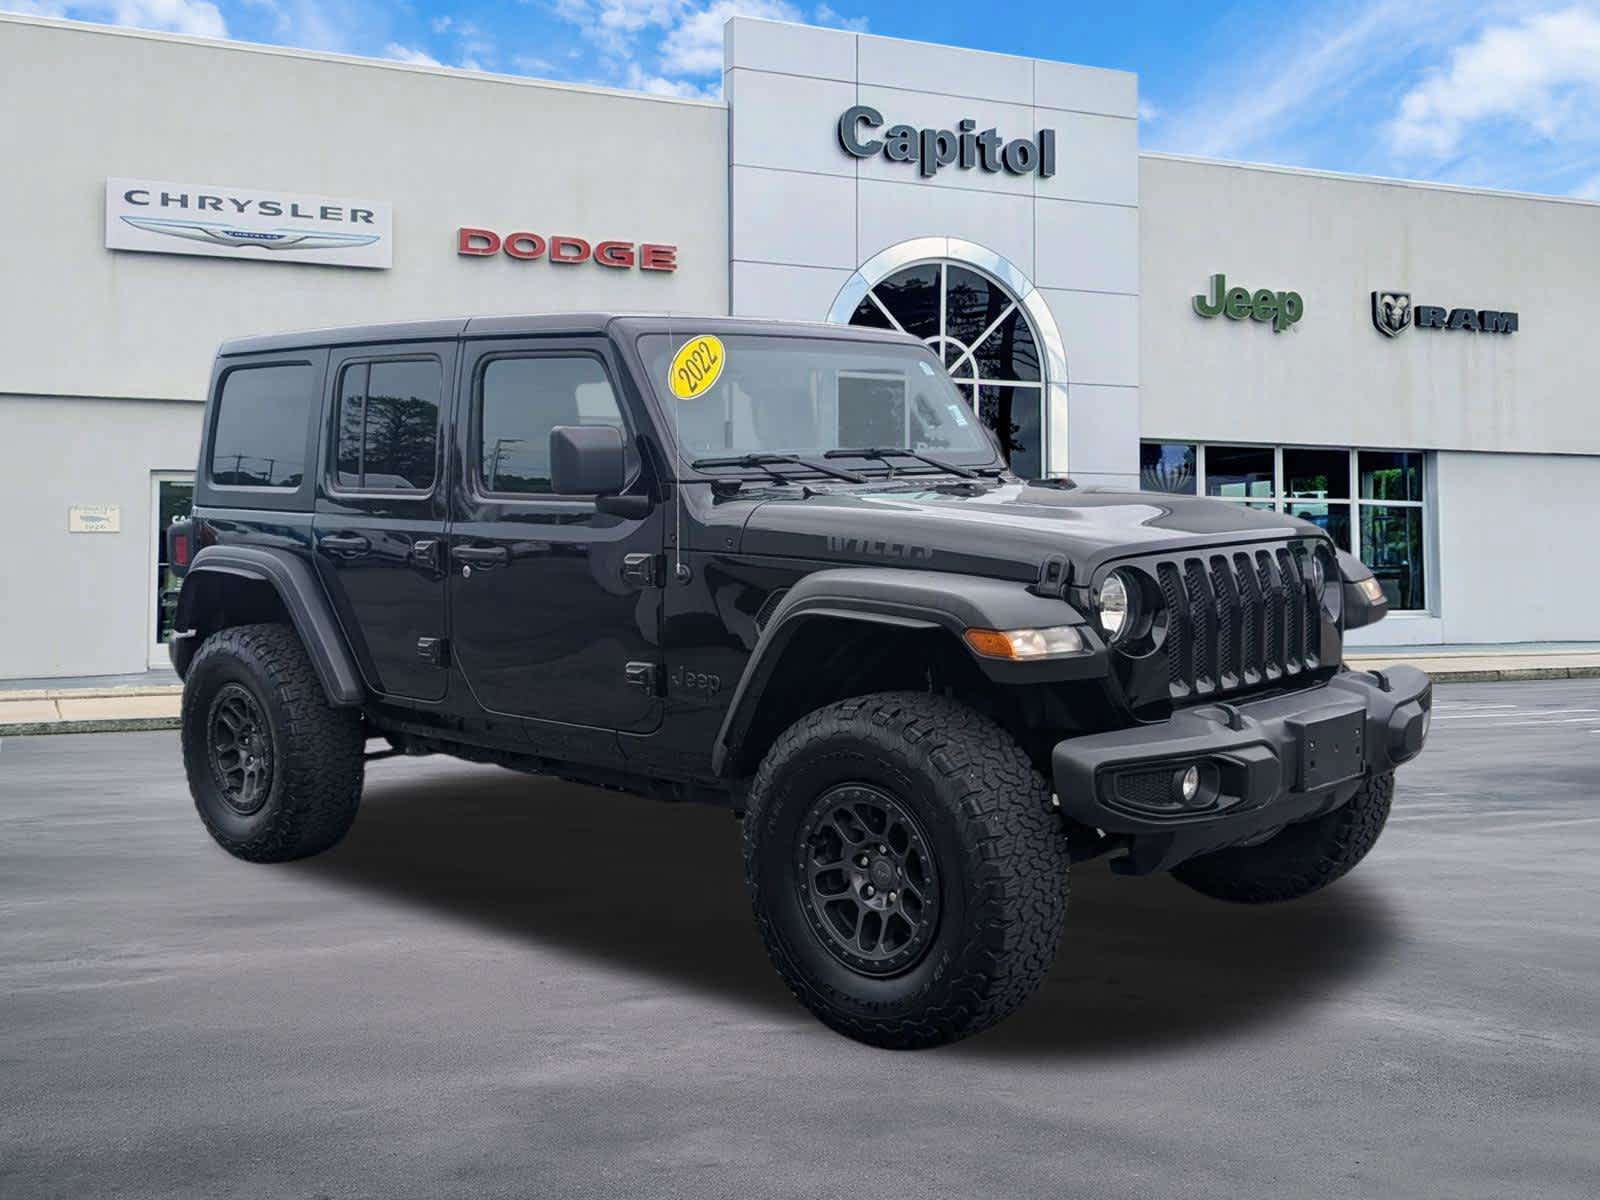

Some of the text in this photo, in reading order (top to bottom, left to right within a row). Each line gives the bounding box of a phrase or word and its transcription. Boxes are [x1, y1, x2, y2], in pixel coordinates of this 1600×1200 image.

[838, 105, 1056, 177] Capitol
[124, 189, 375, 225] CHRYSLER
[457, 227, 678, 272] DODGE
[1192, 273, 1304, 333] Jeep
[1414, 305, 1519, 334] RAM
[678, 341, 718, 392] 2022
[671, 665, 721, 693] Jeep
